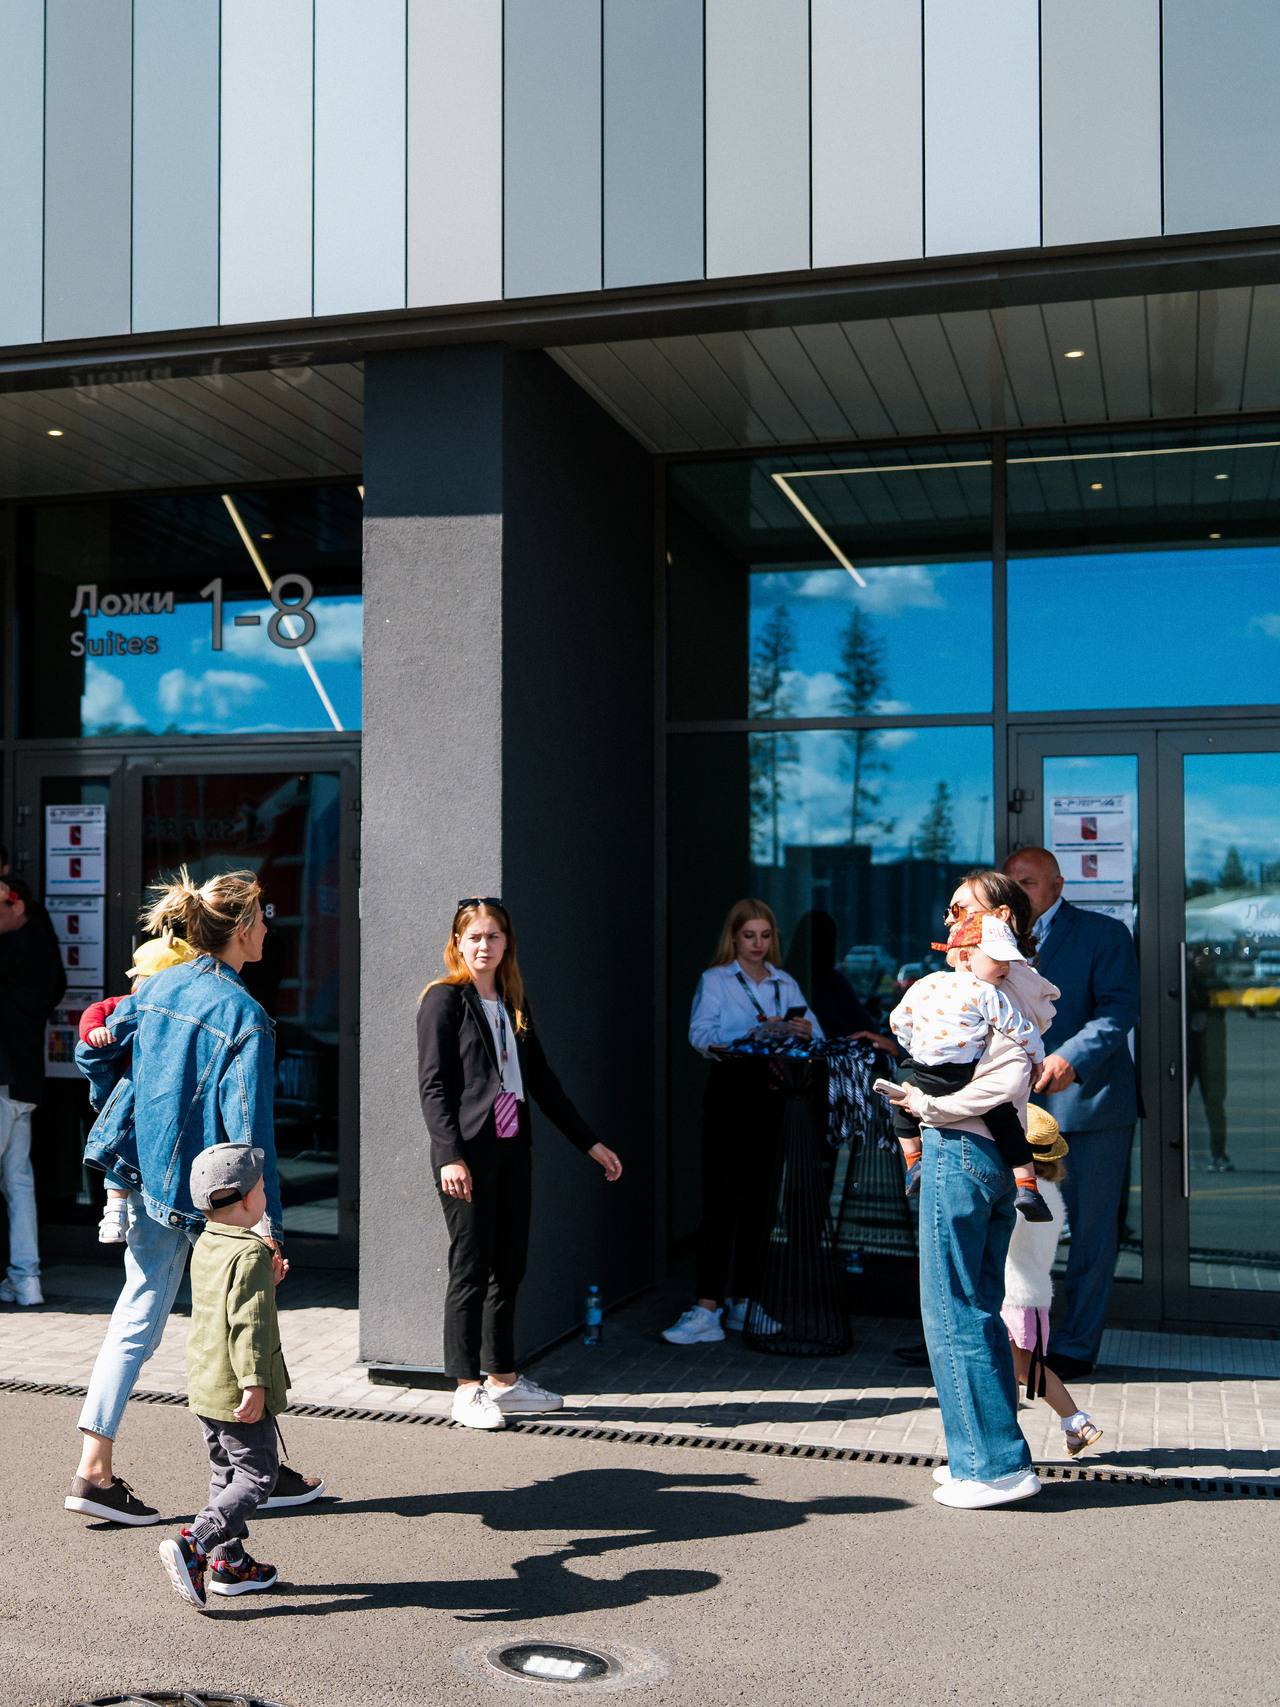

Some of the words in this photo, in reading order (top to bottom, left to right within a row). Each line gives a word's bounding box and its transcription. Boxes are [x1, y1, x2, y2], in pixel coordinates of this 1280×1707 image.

[70, 584, 175, 618] Ложи
[199, 573, 316, 651] 1-8
[70, 631, 159, 657] Suites
